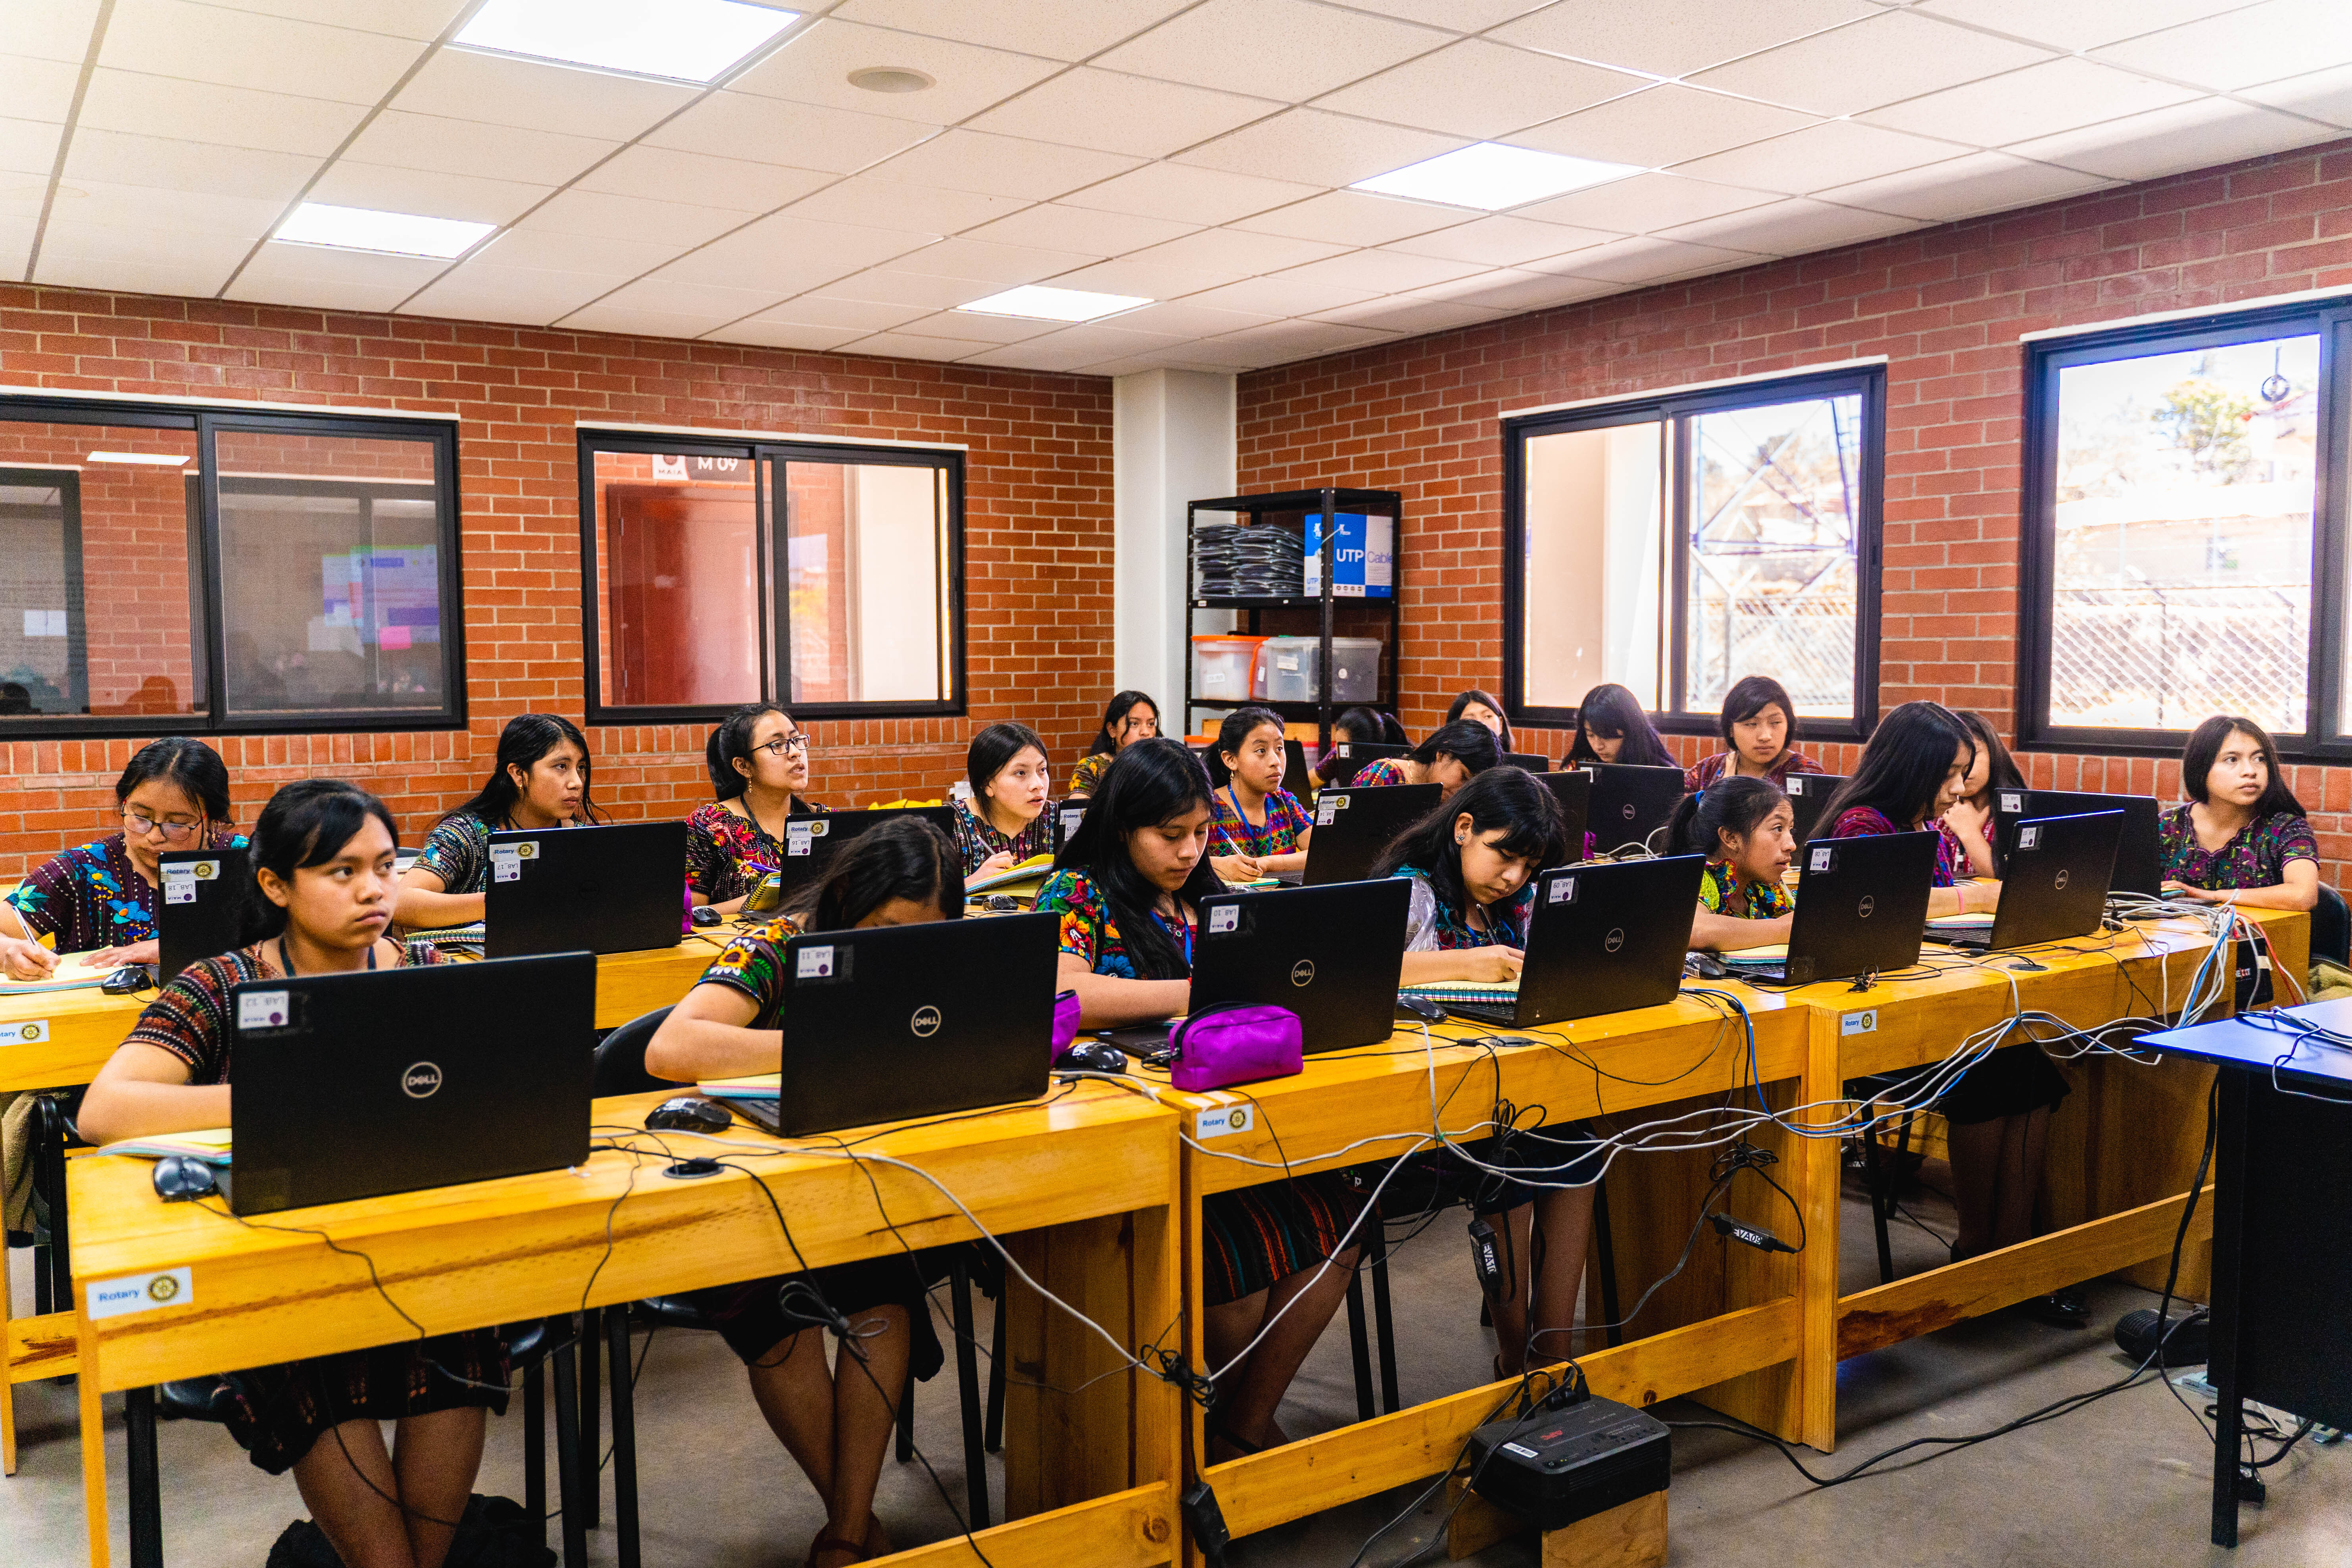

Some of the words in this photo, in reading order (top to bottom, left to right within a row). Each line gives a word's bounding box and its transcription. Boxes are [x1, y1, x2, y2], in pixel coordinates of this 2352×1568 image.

[698, 457, 713, 470] M
[717, 457, 738, 471] 09
[1336, 548, 1364, 563] UTP
[1295, 969, 1312, 978] DELL
[915, 1016, 938, 1027] DELL
[408, 1074, 438, 1086] DELL
[1203, 1118, 1225, 1127] Rotary
[98, 1289, 140, 1303] Rotary
